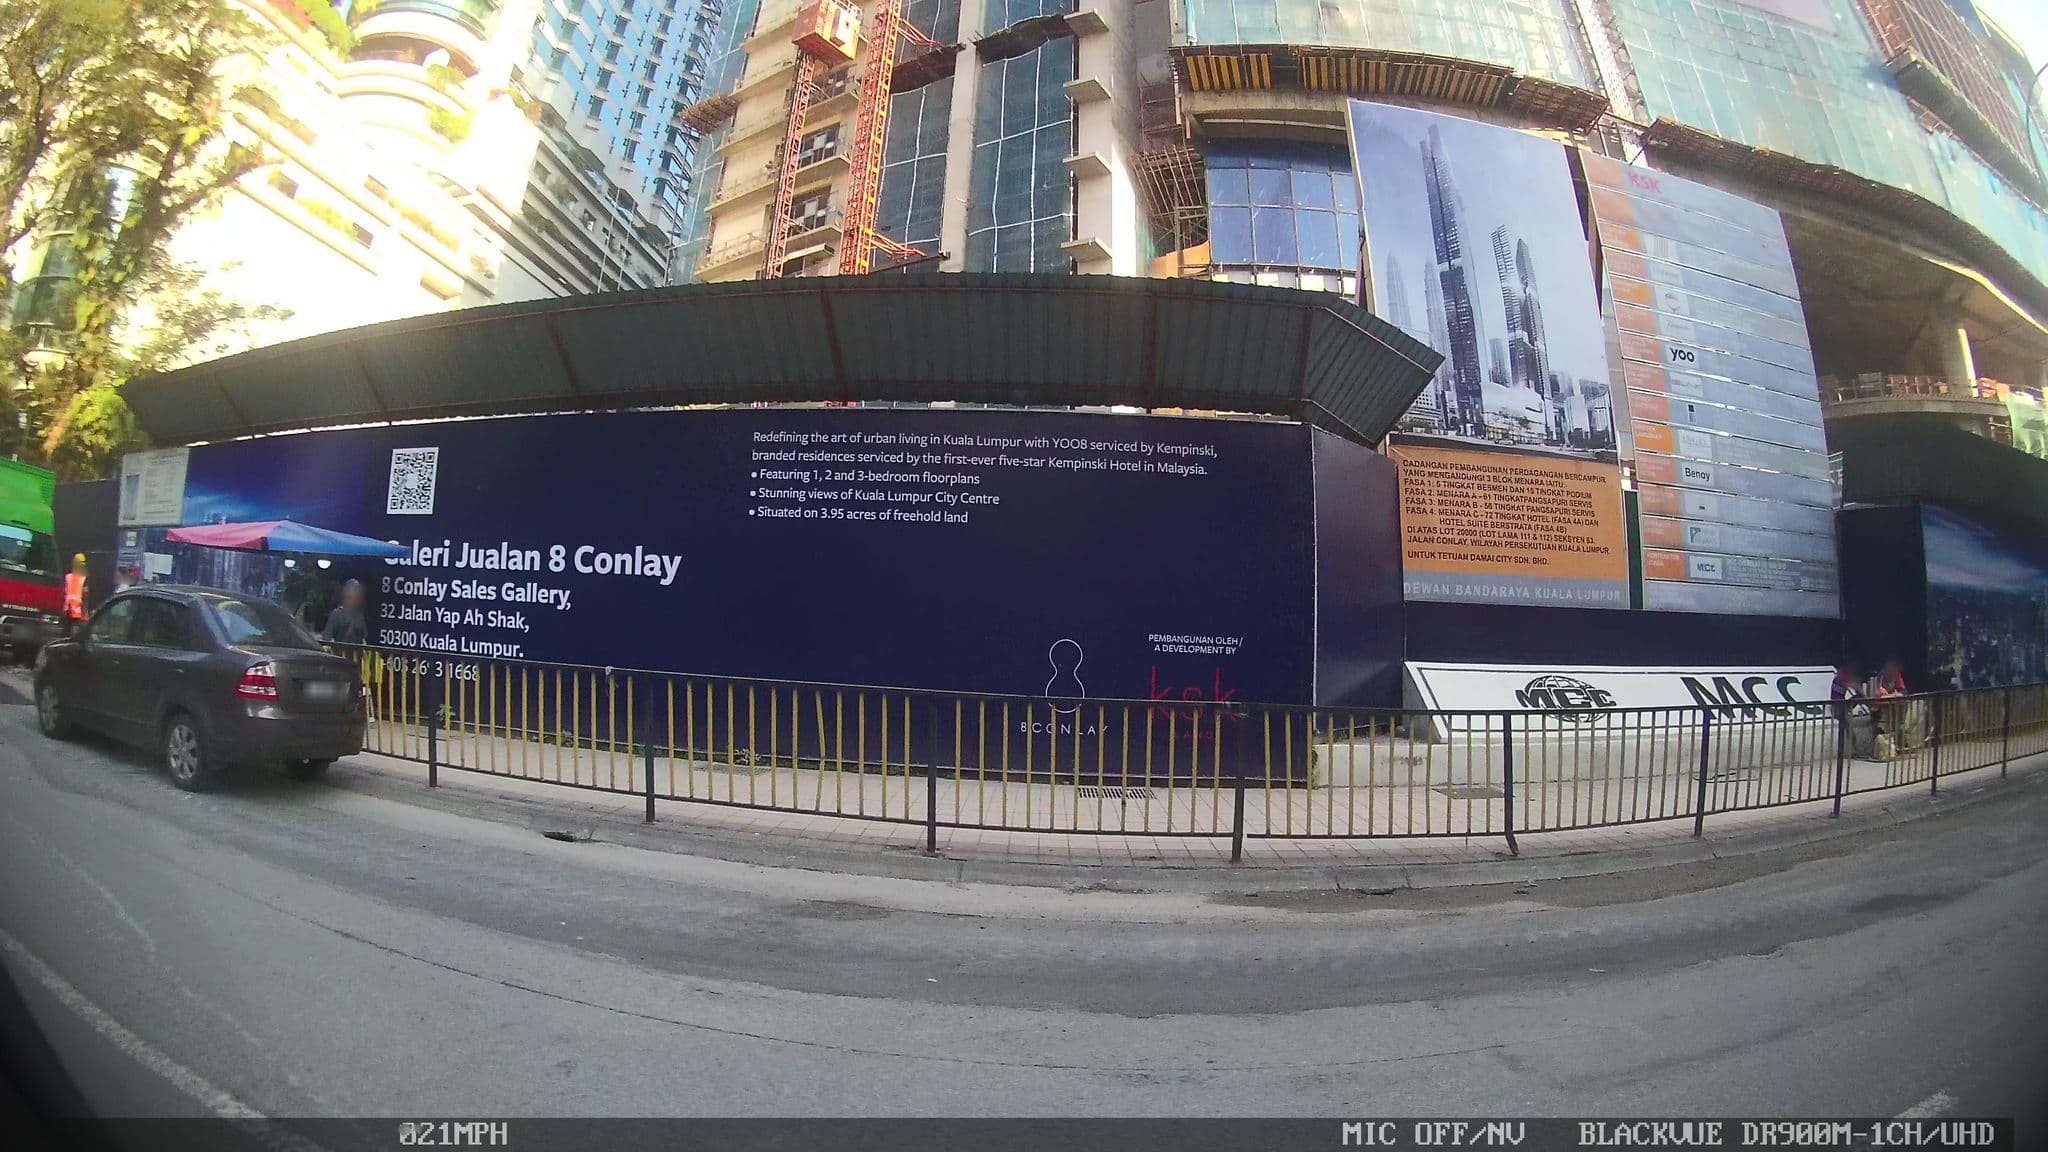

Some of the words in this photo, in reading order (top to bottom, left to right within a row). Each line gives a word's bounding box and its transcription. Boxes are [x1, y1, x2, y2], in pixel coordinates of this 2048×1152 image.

[1670, 347, 1695, 362] yoo
[753, 432, 809, 445] Redefining
[811, 433, 829, 442] the
[831, 434, 847, 443] art
[850, 432, 862, 443] of
[864, 433, 896, 444] urban
[899, 433, 928, 447] living
[930, 434, 940, 444] in
[943, 434, 973, 446] Kuala
[976, 436, 1022, 449] Lumpur
[1024, 436, 1049, 448] with
[1090, 440, 1137, 452] serviced
[1141, 442, 1154, 455] by
[1157, 443, 1217, 458] Kempinski,
[752, 450, 795, 461] branded
[798, 451, 855, 462] residences
[857, 451, 903, 463] serviced
[906, 452, 920, 466] by
[923, 453, 941, 464] the
[944, 453, 996, 465] first-ever
[999, 455, 1046, 467] five-star
[1048, 457, 1107, 471] Kempinski
[1110, 460, 1141, 472] Hotel
[1144, 461, 1154, 472] in
[1157, 462, 1208, 477] Malaysia.
[1403, 460, 1448, 470] CADANGAN
[1450, 463, 1508, 473] PEMBANGUNAN
[1509, 468, 1563, 479] PERDAGANGAN
[760, 469, 810, 483] Featuring
[813, 470, 822, 482] 1,
[825, 470, 832, 480] 2
[834, 470, 854, 481] and
[857, 470, 920, 483] 3-bedroom
[923, 471, 980, 486] floorplans
[1403, 469, 1425, 477] YANG
[1492, 475, 1513, 484] BLOK
[1514, 477, 1544, 486] MENARA
[1404, 478, 1425, 486] FASA
[1442, 481, 1475, 490] TINGKAT
[1509, 485, 1524, 493] DAN
[1536, 488, 1564, 497] TINGKAT
[1405, 488, 1426, 496] FASA
[1437, 490, 1470, 499] MENARA
[758, 487, 806, 502] Stunning
[808, 488, 838, 500] views
[841, 489, 853, 500] of
[855, 489, 885, 501] Kuala
[888, 490, 932, 504] Lumpur
[935, 491, 958, 506] City
[960, 492, 1000, 505] Centre
[1405, 497, 1427, 505] FASA
[1438, 499, 1472, 508] MENARA
[1494, 503, 1525, 512] TINGKAT
[757, 506, 801, 518] Situated
[804, 509, 818, 518] on
[821, 507, 844, 519] 3.95
[847, 510, 876, 520] acres
[879, 509, 892, 520] of
[893, 509, 941, 522] freehold
[944, 511, 968, 523] land
[1405, 506, 1427, 515] FASA
[1438, 509, 1471, 518] MENARA
[1494, 512, 1525, 521] TINGKAT
[1527, 514, 1550, 523] HOTEL
[1585, 519, 1599, 527] DAN
[1417, 526, 1437, 534] ATAS
[1498, 531, 1518, 539] LAMA
[1440, 518, 1465, 527] HOTEL
[1467, 520, 1488, 528] SUITE
[1490, 521, 1534, 531] BERSTRATA
[1470, 539, 1503, 547] WILAYAH
[1505, 541, 1557, 551] PERSEKUTUAN
[1558, 544, 1581, 552] KUALA
[455, 542, 541, 570] Jualan
[549, 544, 566, 572] 8
[574, 545, 682, 585] Conlay
[1407, 551, 1436, 559] UNTUK
[1437, 552, 1468, 560] TETUAN
[1470, 554, 1495, 562] DAMAI
[1496, 555, 1512, 563] CITY
[381, 576, 391, 593] 8
[394, 577, 448, 602] Conlay
[450, 579, 497, 600] Sales
[501, 582, 571, 610] Gallery,
[1403, 582, 1450, 595] DEWAN
[1455, 584, 1530, 598] BANDARAYA
[1535, 588, 1573, 599] KUALA
[1577, 589, 1620, 600] LUMPUR
[380, 603, 395, 618] 32
[398, 604, 431, 622] Jalan
[435, 607, 460, 628] Yap
[464, 609, 483, 626] Ah
[487, 610, 529, 633] Shak,
[379, 629, 417, 647] 50300
[420, 633, 457, 651] Kuala
[461, 637, 524, 658] Lumpur.
[1149, 634, 1213, 644] PEMBANGUNAN
[1154, 644, 1161, 652] A
[1162, 645, 1224, 654] DEVELOPMENT
[1515, 688, 1617, 708] MCC
[1680, 676, 1824, 720] MCC
[1020, 722, 1108, 736] 8CONA
